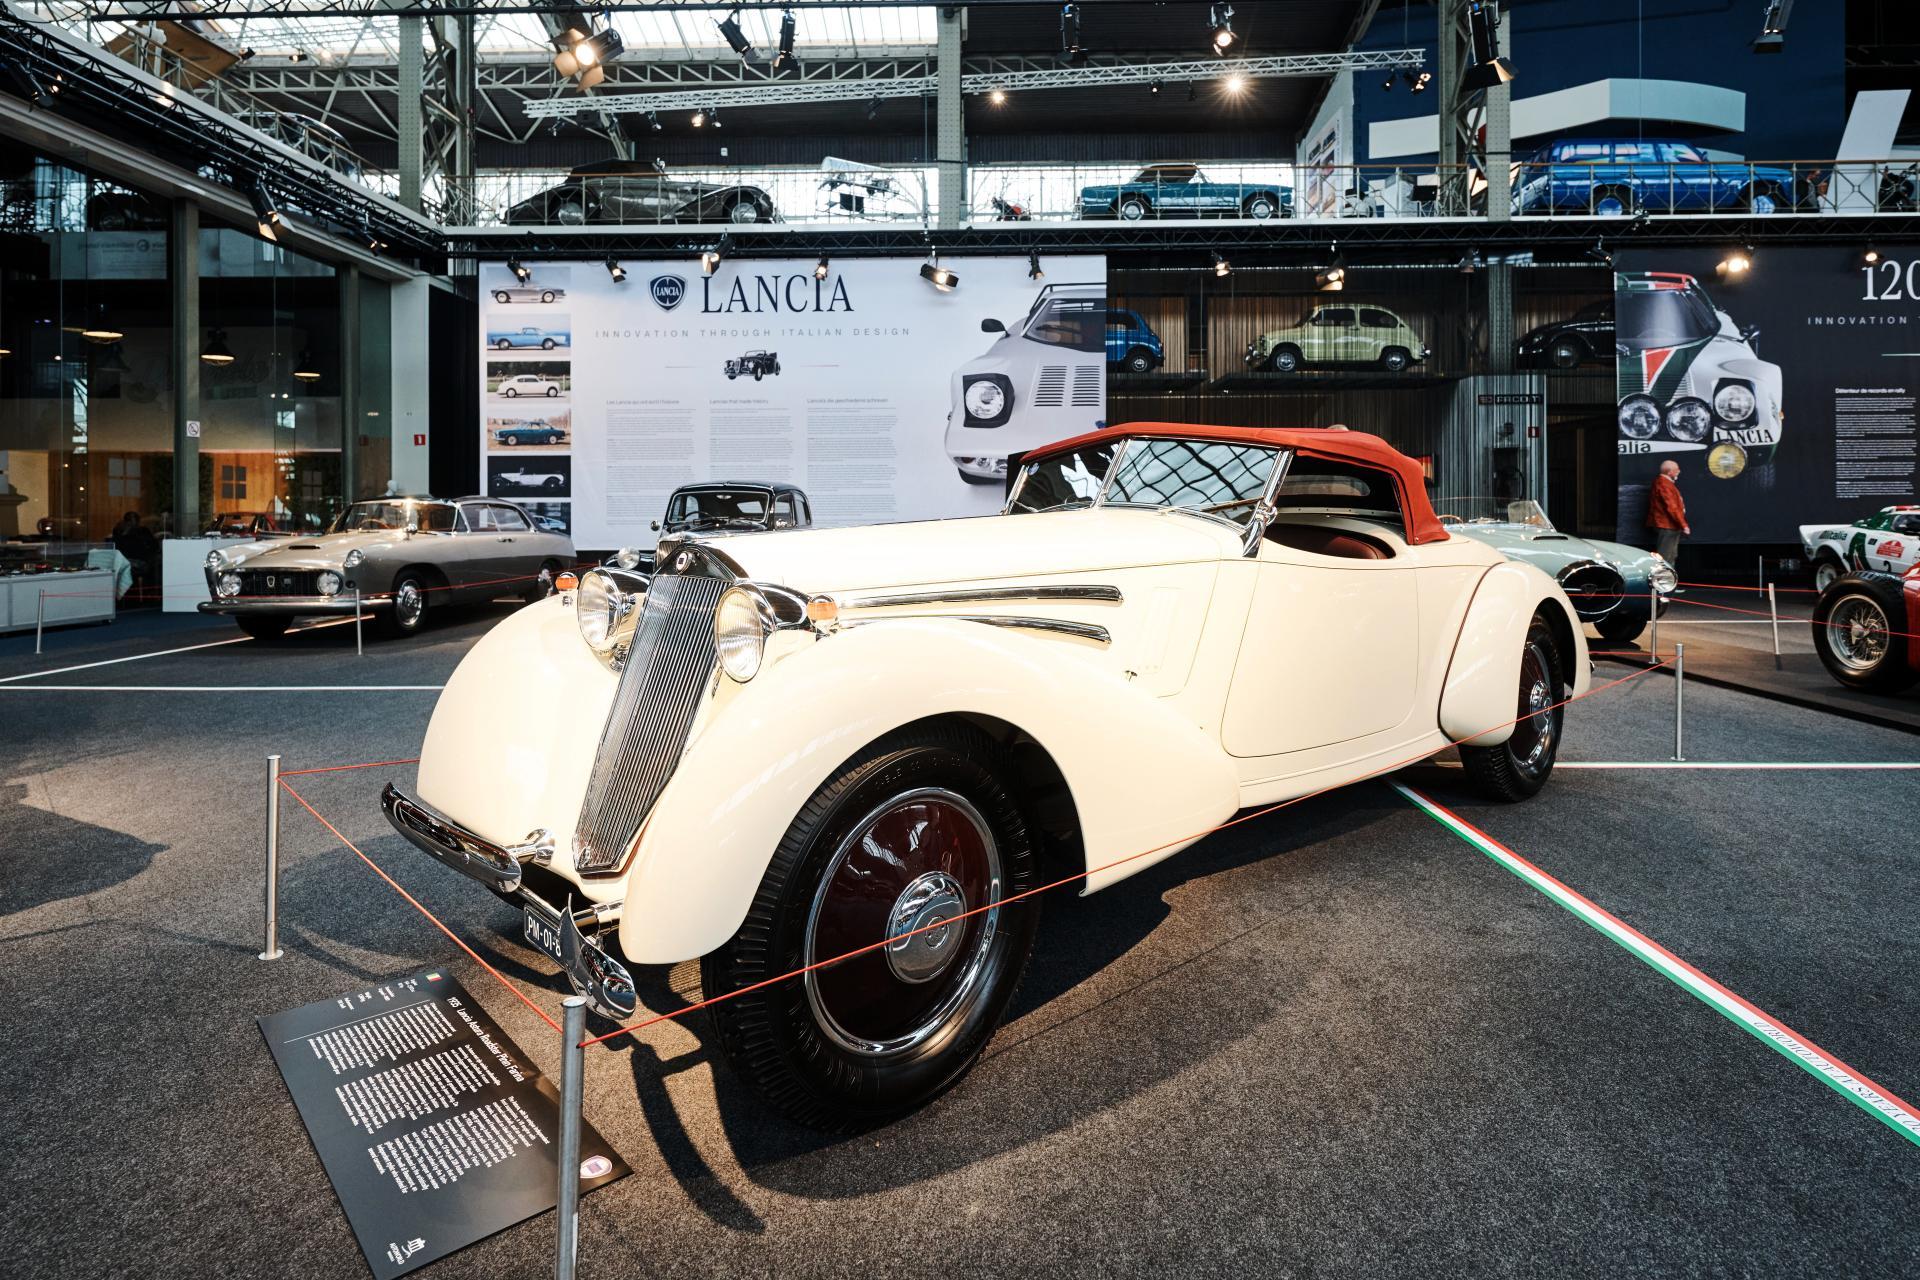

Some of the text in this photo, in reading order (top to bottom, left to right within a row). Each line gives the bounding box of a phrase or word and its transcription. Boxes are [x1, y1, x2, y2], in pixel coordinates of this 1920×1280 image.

[656, 287, 680, 297] LANCIA
[701, 274, 854, 313] LANCIA
[1808, 316, 1907, 325] INNOVATION
[595, 328, 910, 338] INNOVATION THROUGH ITALIAN DESIGN
[1716, 429, 1773, 444] LANCIA
[447, 996, 462, 1008] 1935
[457, 1008, 473, 1022] Lancia
[467, 1020, 483, 1036] Astura
[478, 1033, 502, 1055] Roadster
[496, 1053, 512, 1067] Pinin
[506, 1064, 525, 1082] Farina
